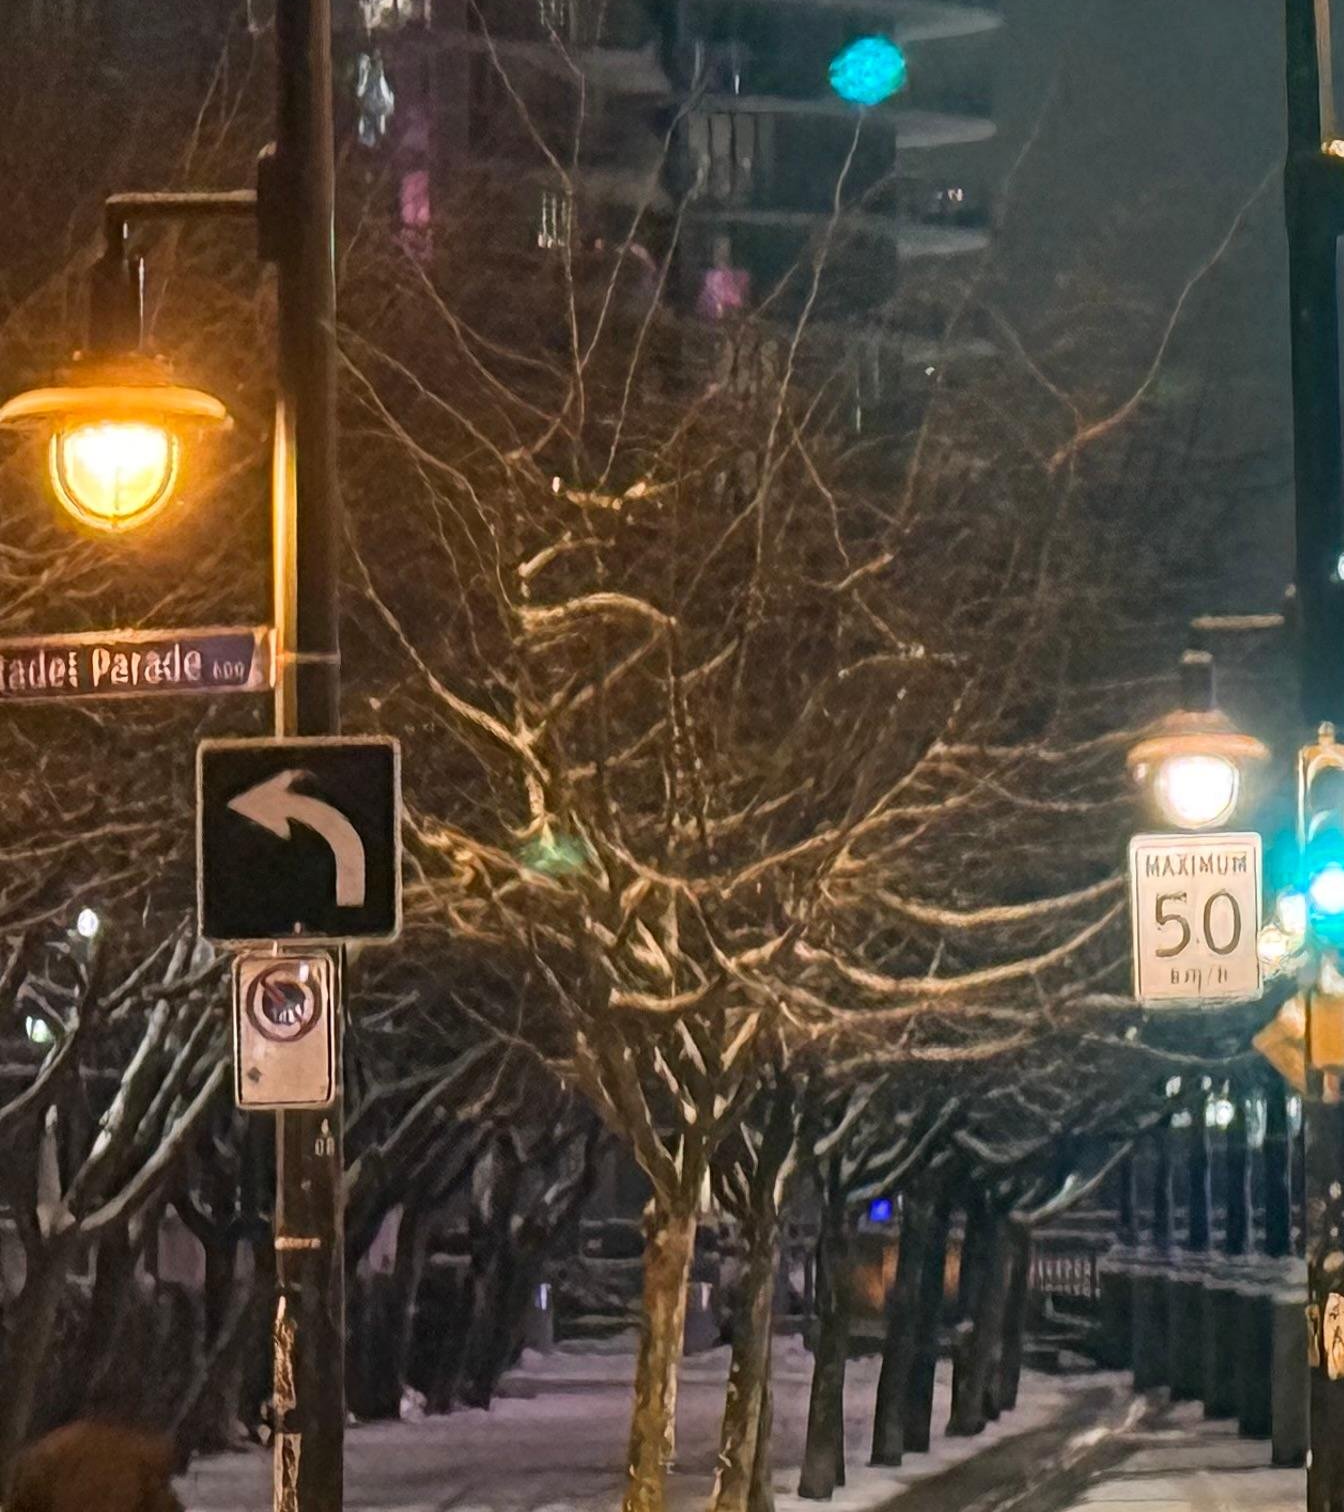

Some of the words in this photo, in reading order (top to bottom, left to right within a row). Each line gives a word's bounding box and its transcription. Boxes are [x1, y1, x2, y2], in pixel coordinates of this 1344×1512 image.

[92, 643, 202, 688] Parade
[1145, 852, 1248, 879] MAXIMUM
[1155, 889, 1242, 958] 50
